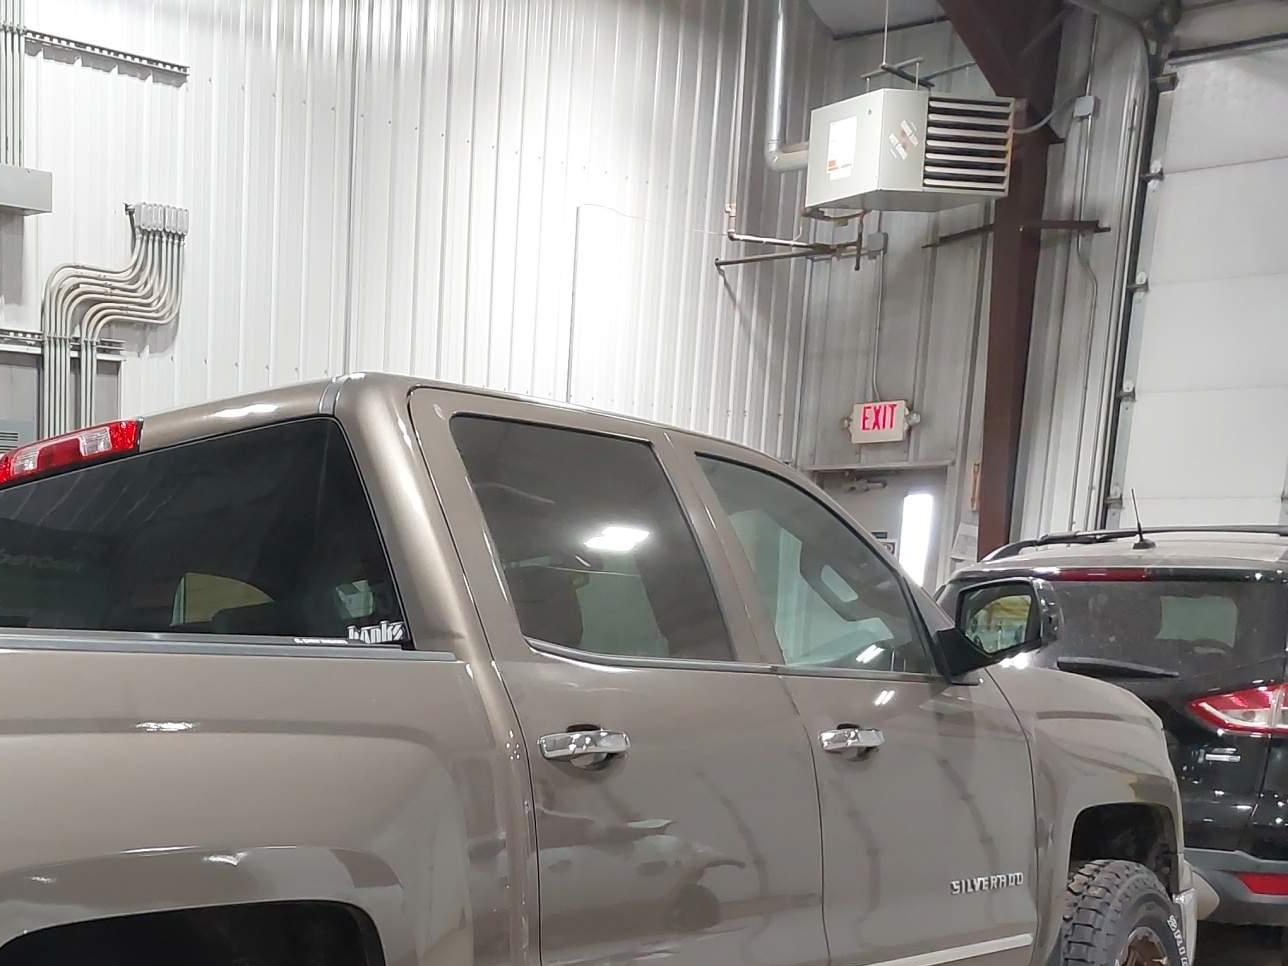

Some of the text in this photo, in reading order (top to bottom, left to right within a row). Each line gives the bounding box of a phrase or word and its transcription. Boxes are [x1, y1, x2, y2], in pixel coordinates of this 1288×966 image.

[862, 404, 897, 430] EXIT
[346, 620, 405, 644] banks
[951, 872, 1024, 895] SILVERADO
